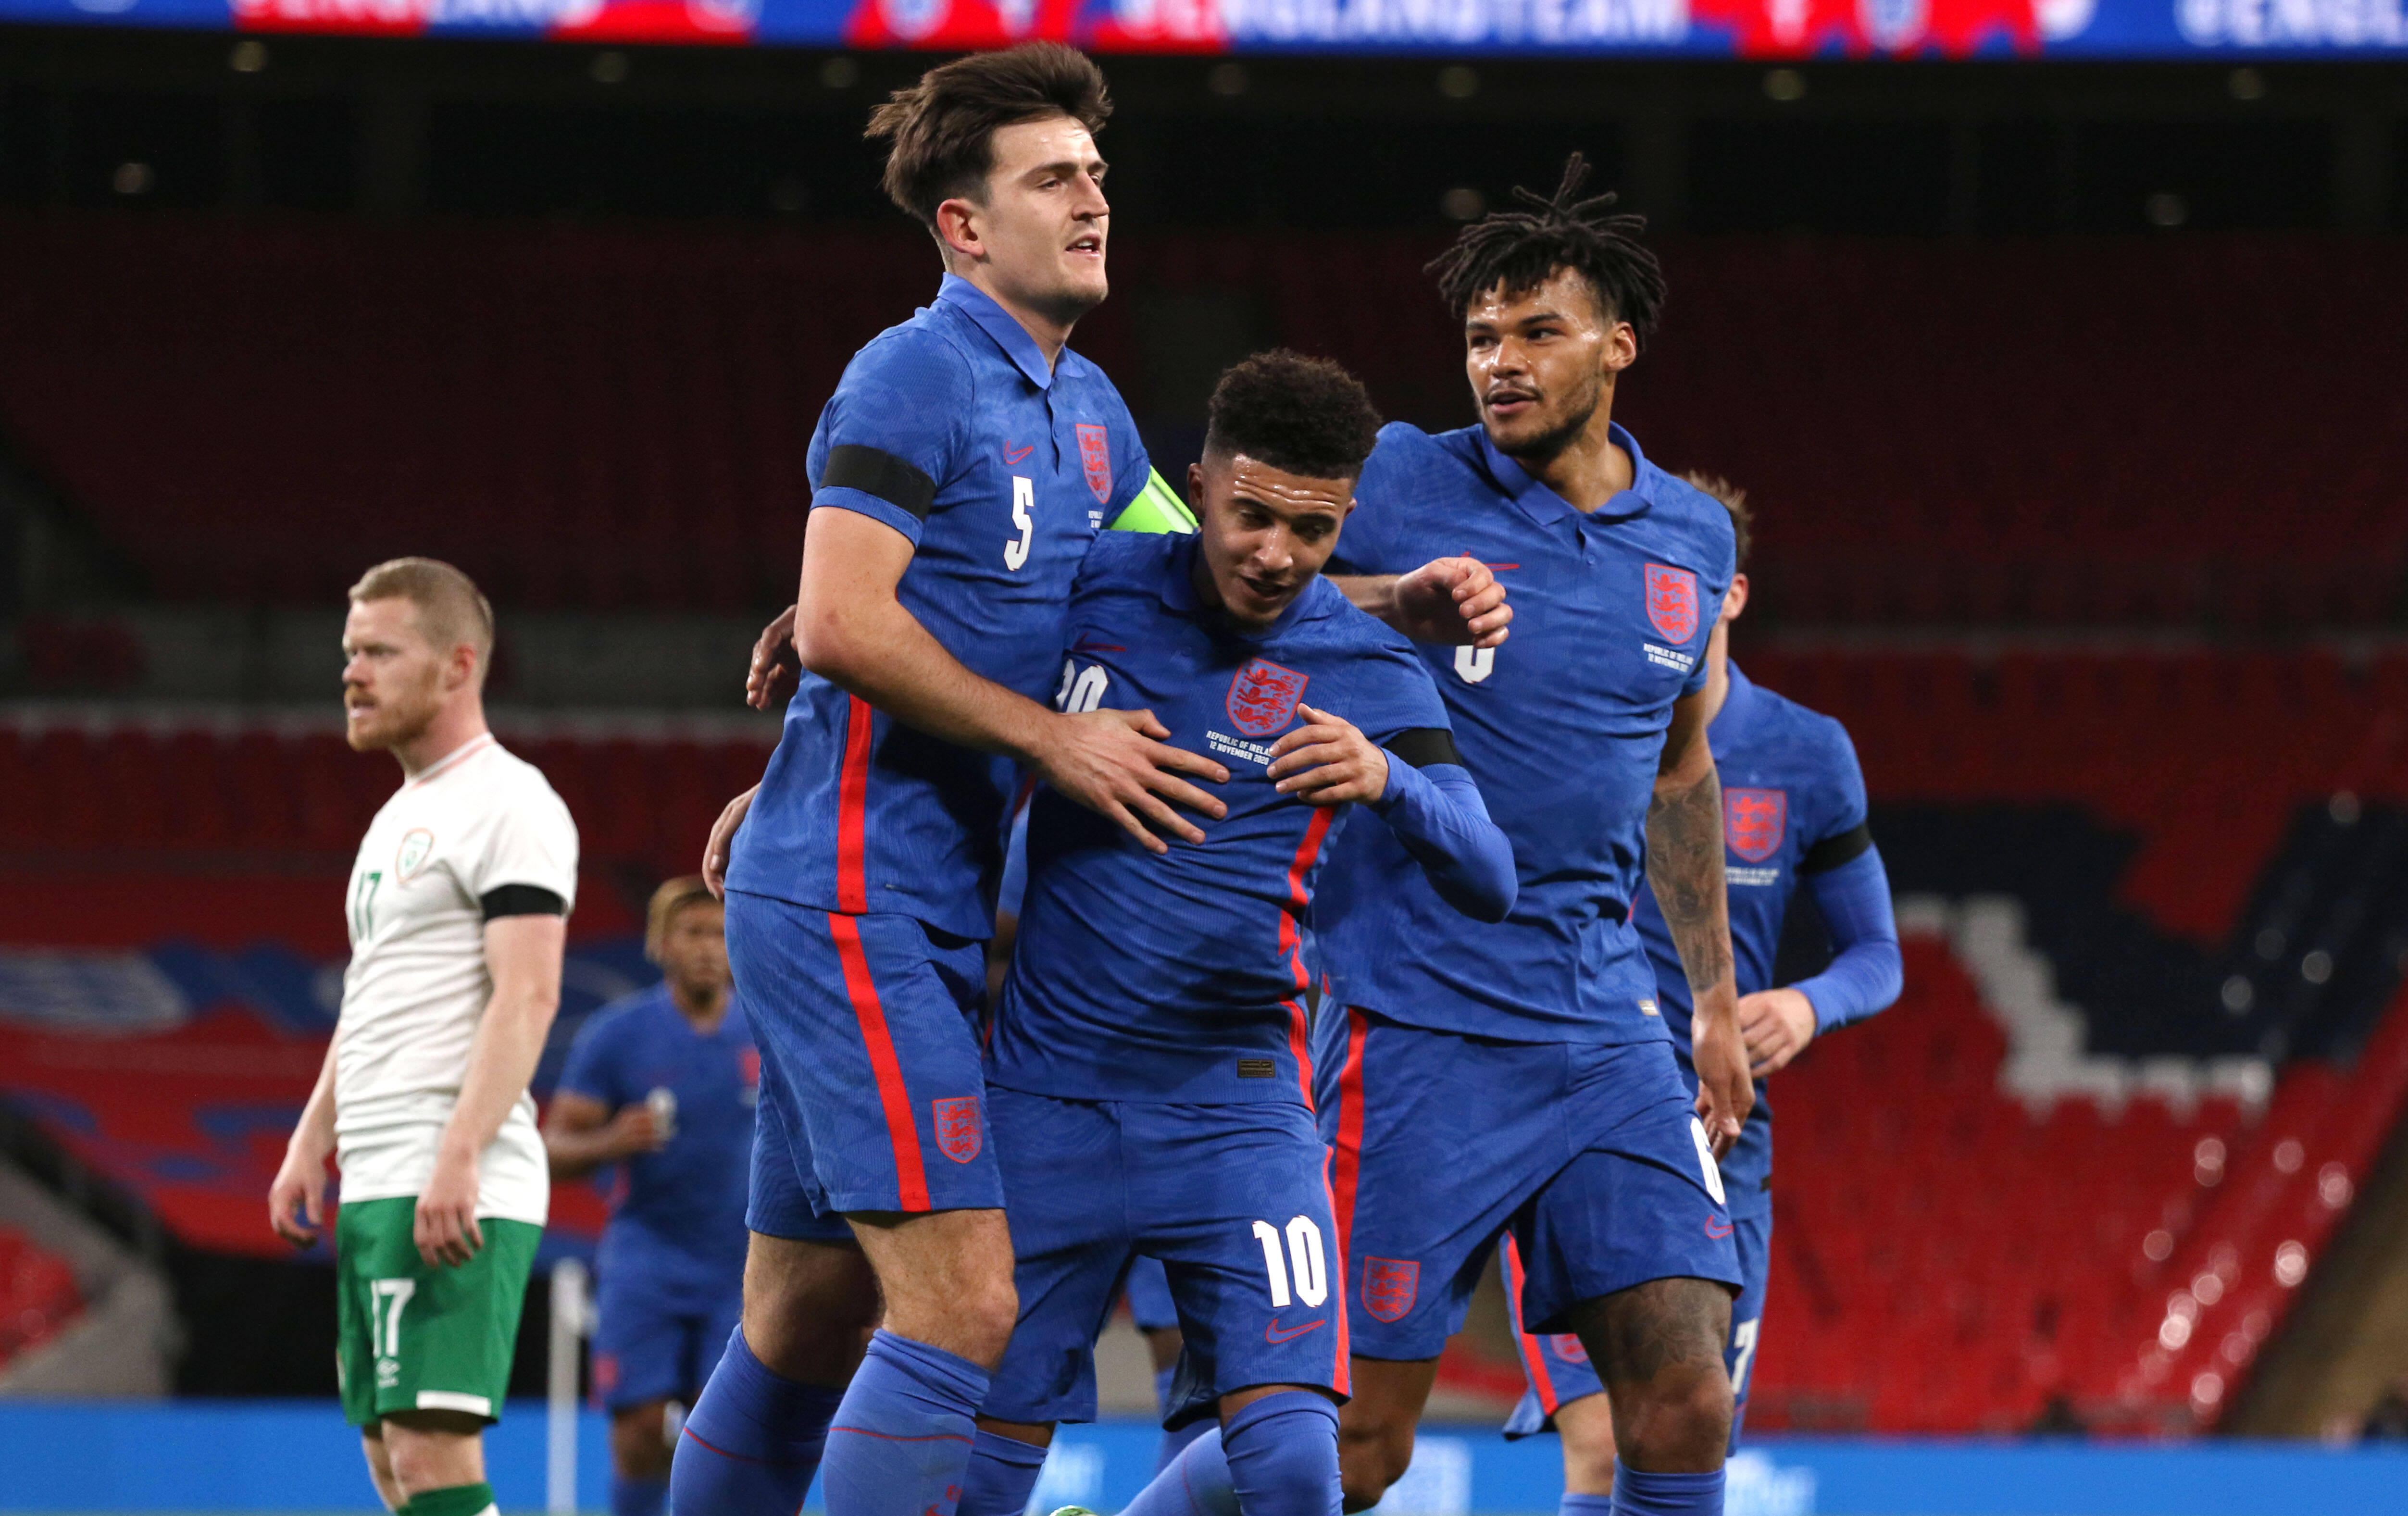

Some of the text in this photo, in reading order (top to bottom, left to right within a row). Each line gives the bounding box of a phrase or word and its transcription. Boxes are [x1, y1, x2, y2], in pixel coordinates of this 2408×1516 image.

[1004, 476, 1034, 571] 5
[1206, 730, 1239, 746] REPUBLIC
[1239, 741, 1249, 749] OF
[1209, 740, 1270, 766] 12 NOVEMBER 2020
[1690, 1117, 1725, 1205] 6
[1252, 1215, 1328, 1308] 10
[371, 1278, 415, 1358] 17
[1732, 1317, 1759, 1394] 7
